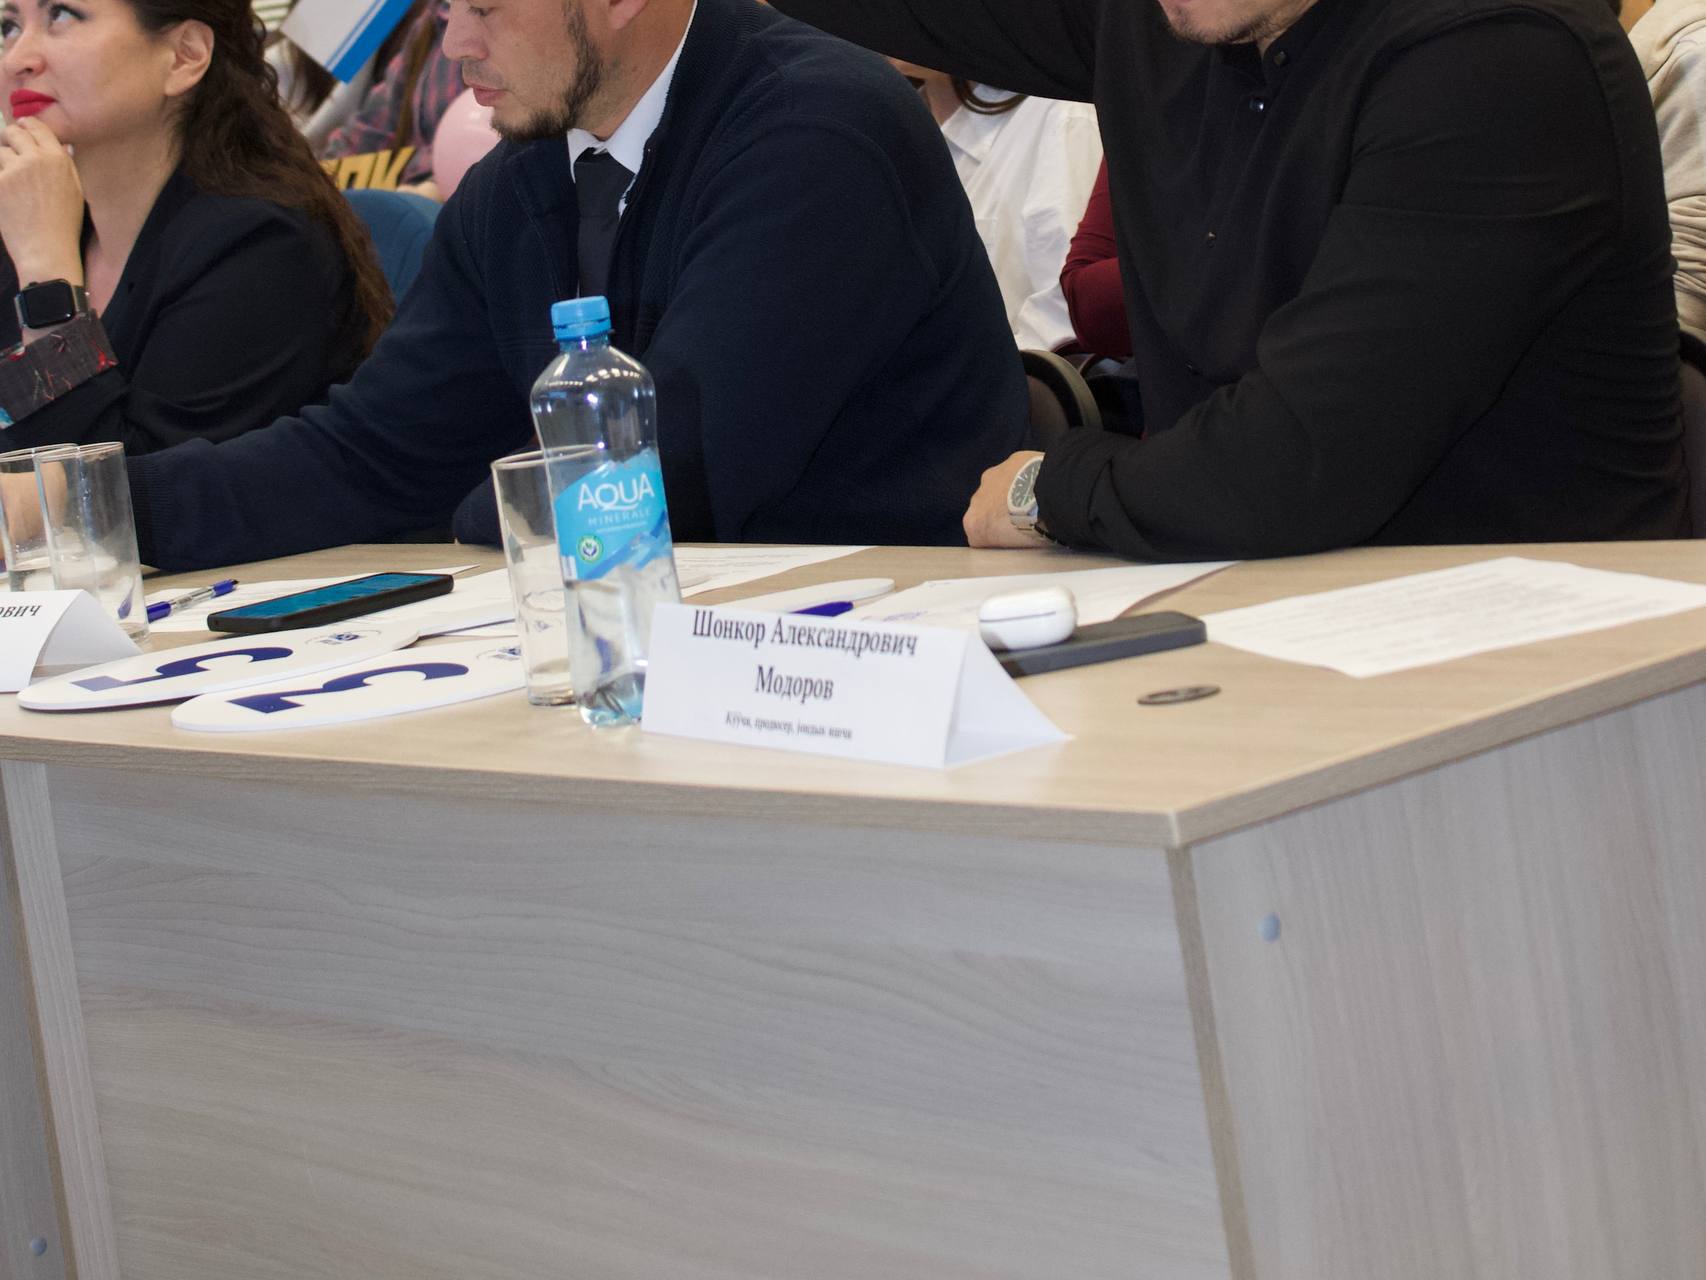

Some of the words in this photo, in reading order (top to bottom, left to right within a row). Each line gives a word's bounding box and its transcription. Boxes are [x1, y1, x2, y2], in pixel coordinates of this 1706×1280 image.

[577, 471, 655, 512] AQUA
[692, 609, 766, 649] Шонкор
[770, 616, 919, 658] Александрович
[754, 664, 835, 704] Модоров
